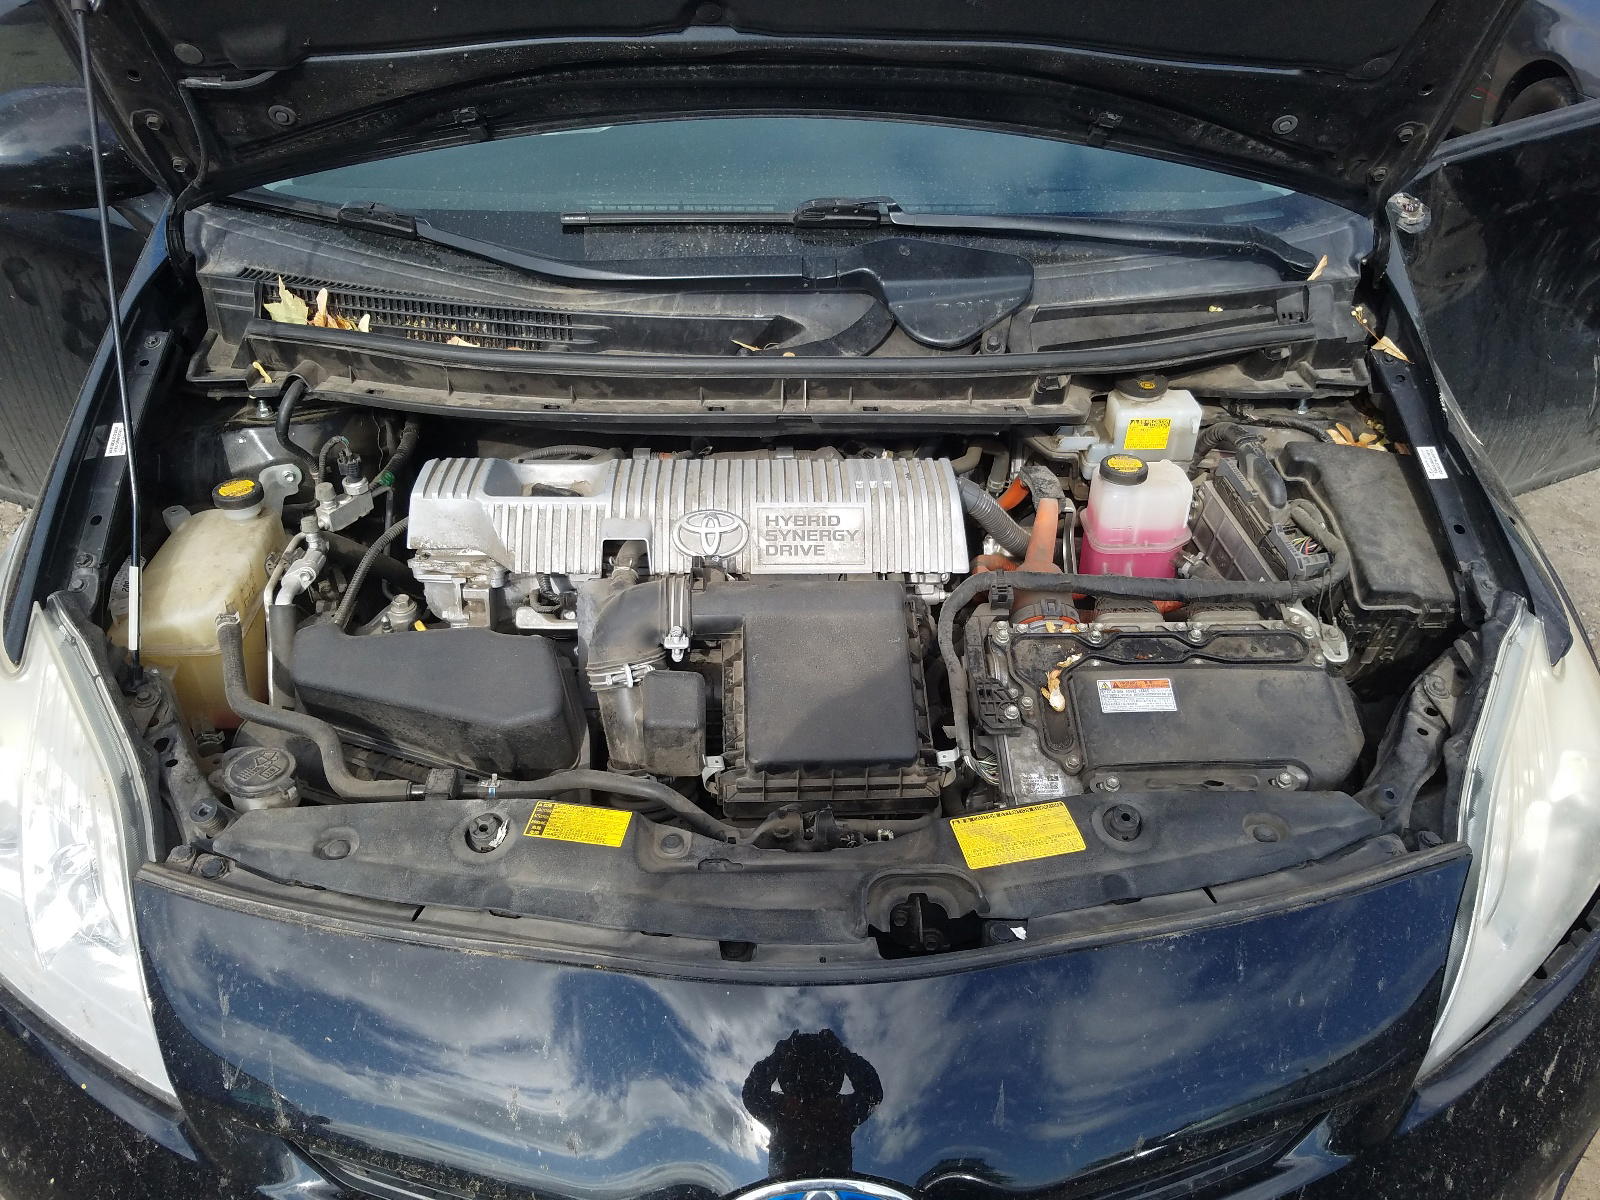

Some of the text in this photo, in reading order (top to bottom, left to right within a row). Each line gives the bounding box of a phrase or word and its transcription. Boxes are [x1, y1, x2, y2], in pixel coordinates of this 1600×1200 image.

[765, 515, 841, 527] HYBRID
[765, 529, 859, 542] SYNERGY
[765, 544, 825, 557] DRIVE
